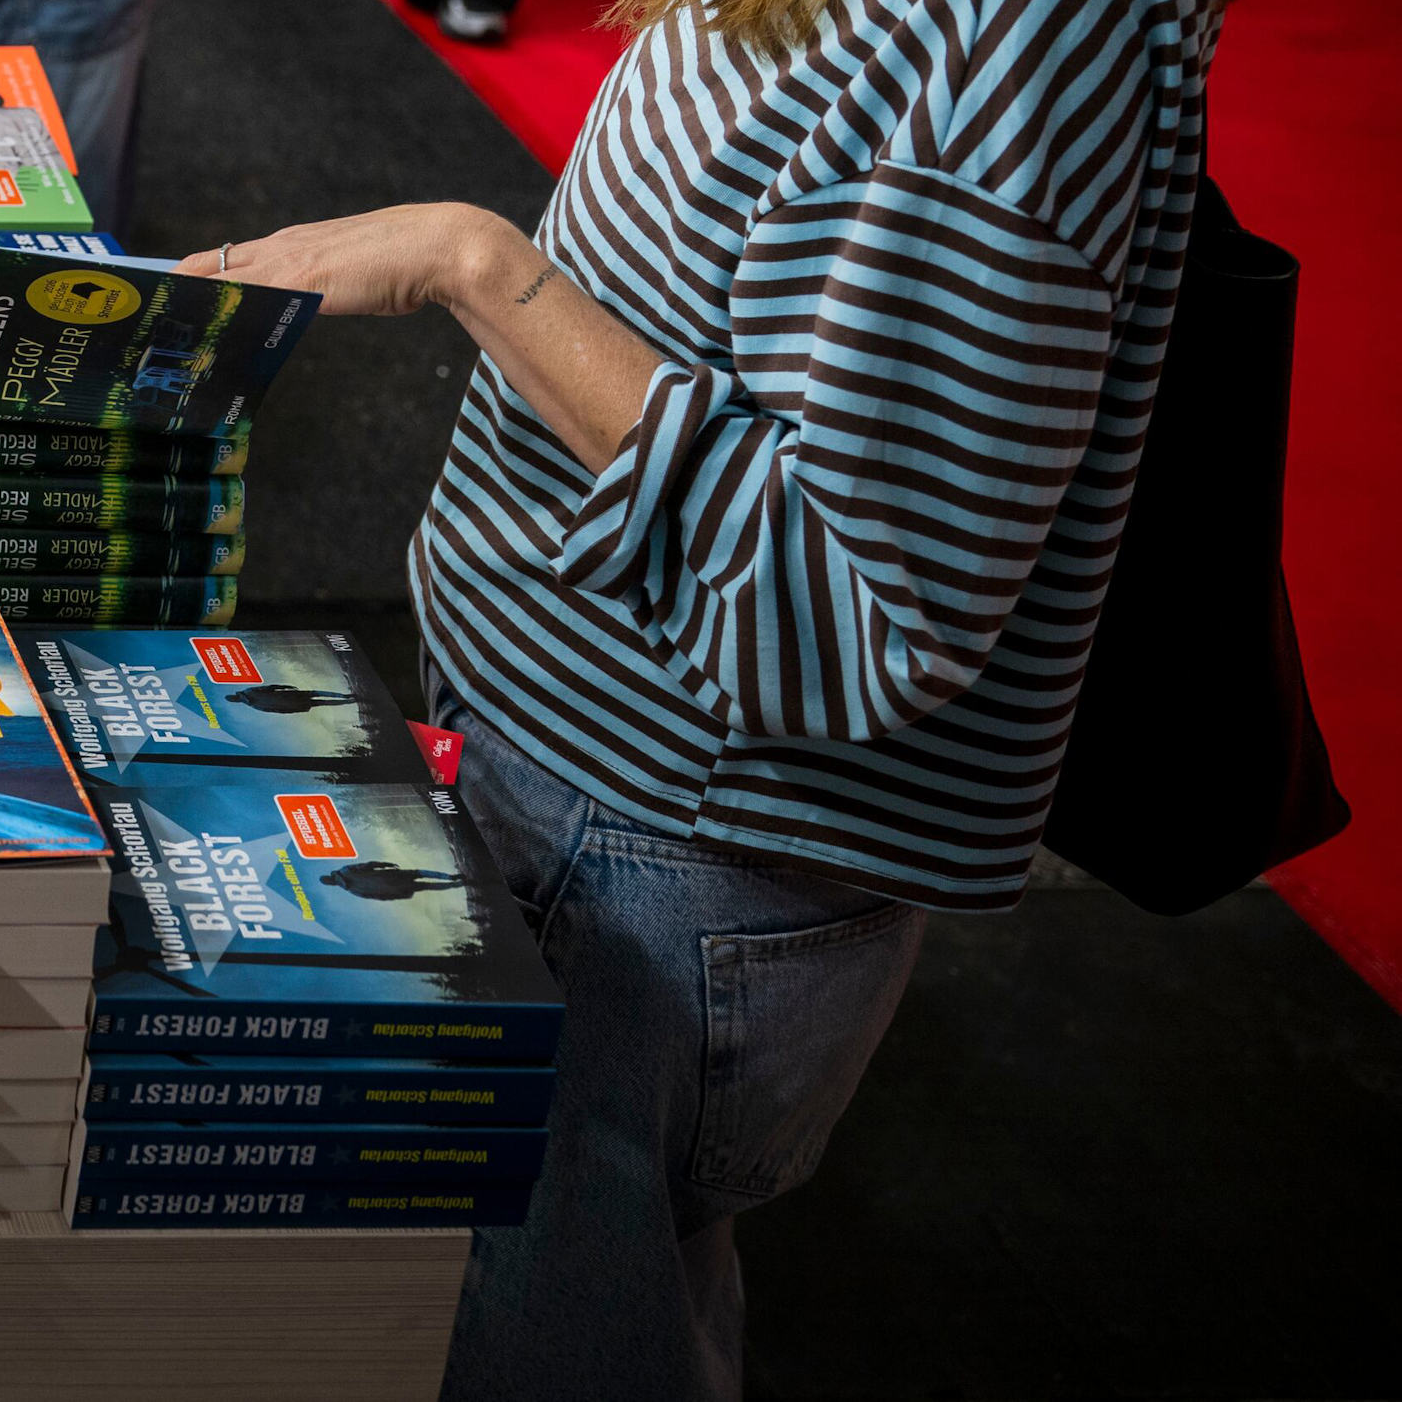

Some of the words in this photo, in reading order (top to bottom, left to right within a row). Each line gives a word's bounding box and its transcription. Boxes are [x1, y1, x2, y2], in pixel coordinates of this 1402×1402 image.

[49, 281, 70, 312] deutscher
[59, 297, 74, 315] buch
[73, 300, 88, 316] preis
[97, 289, 122, 319] Shortlist
[279, 298, 302, 325] BERLIN
[1, 337, 46, 402] PEGGY
[38, 327, 93, 407] MÄDLER
[224, 395, 245, 426] ROMAN
[218, 443, 234, 464] GB
[325, 634, 353, 652] KiWi
[82, 666, 135, 738] BLACK
[119, 661, 192, 745] FOREST
[109, 801, 161, 879] Schorlau
[159, 838, 234, 933] BLACK
[201, 831, 284, 941] FOREST
[143, 883, 195, 973] Wolfgang
[134, 1014, 236, 1039] FOREST
[245, 1015, 329, 1039] BLACK
[129, 1083, 230, 1106] FOREST
[238, 1084, 323, 1106] BLACK
[125, 1144, 226, 1166] FOREST
[232, 1145, 317, 1166] BLACK
[116, 1194, 216, 1215] FOREST
[222, 1195, 306, 1215] BLACK
